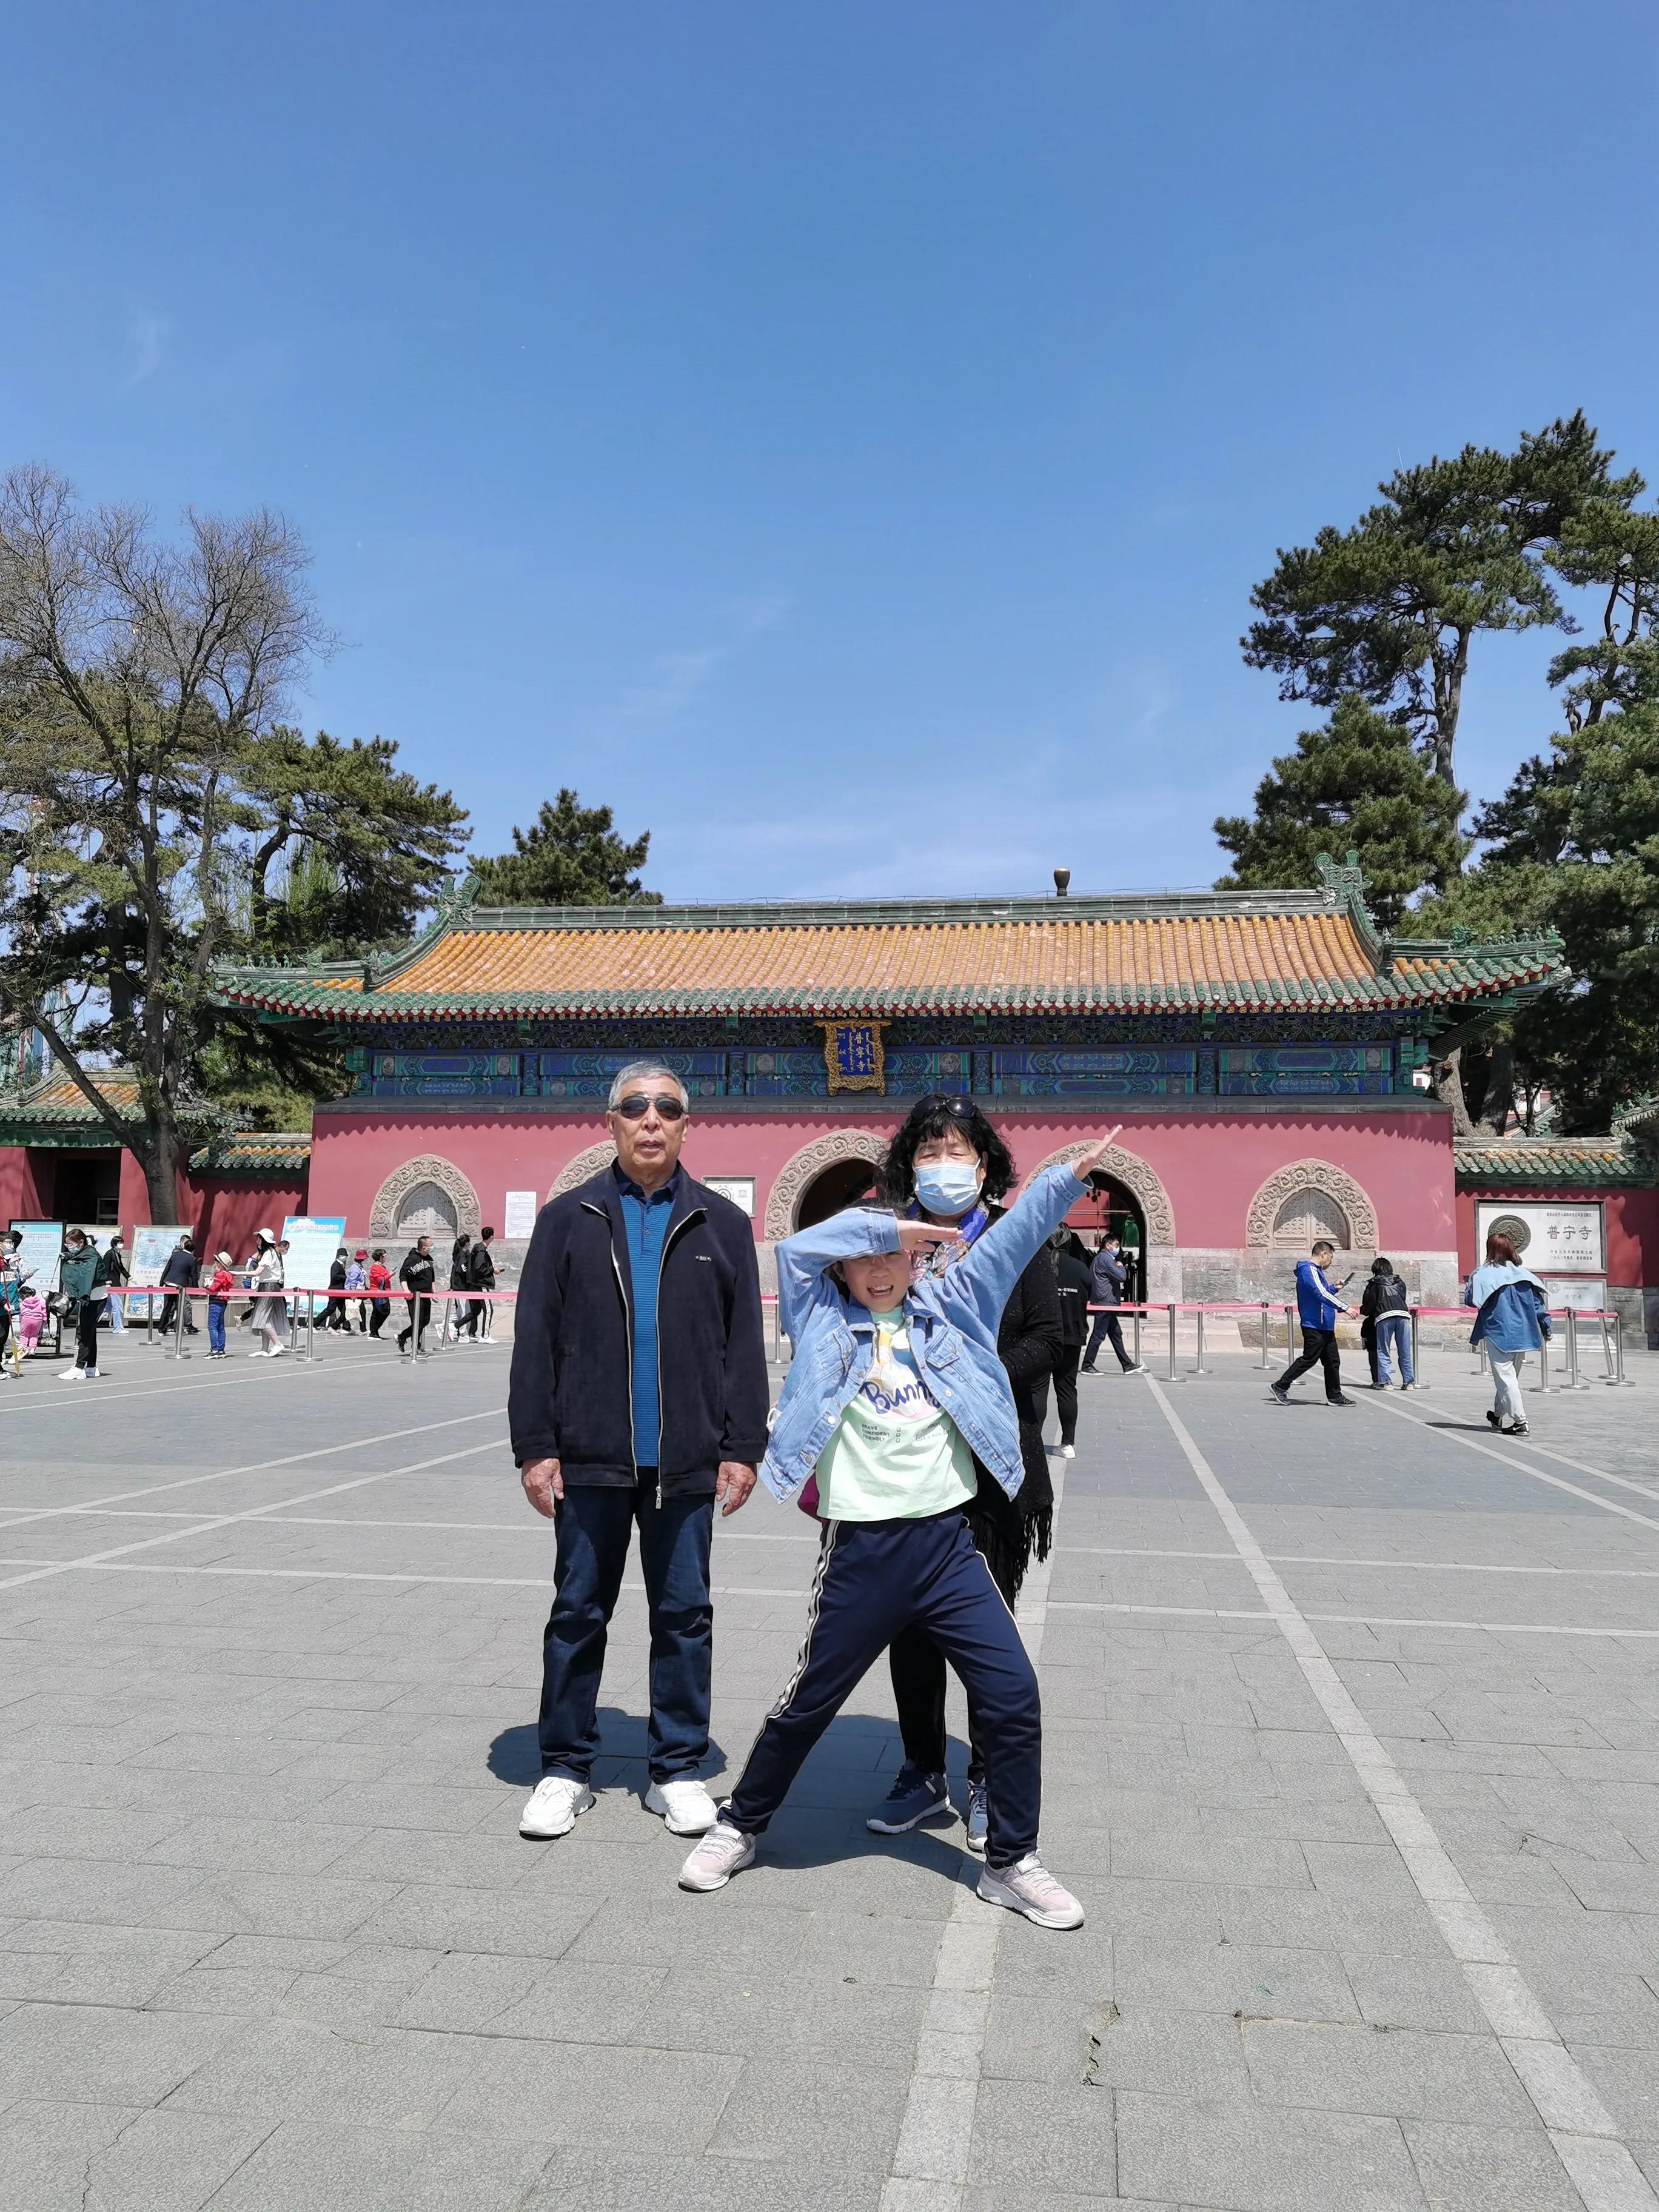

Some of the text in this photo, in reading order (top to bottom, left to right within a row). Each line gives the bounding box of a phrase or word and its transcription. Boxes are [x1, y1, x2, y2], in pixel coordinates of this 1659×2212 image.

[1547, 1224, 1593, 1241] 普宁寺
[862, 1429, 890, 1437] CONFIDENT
